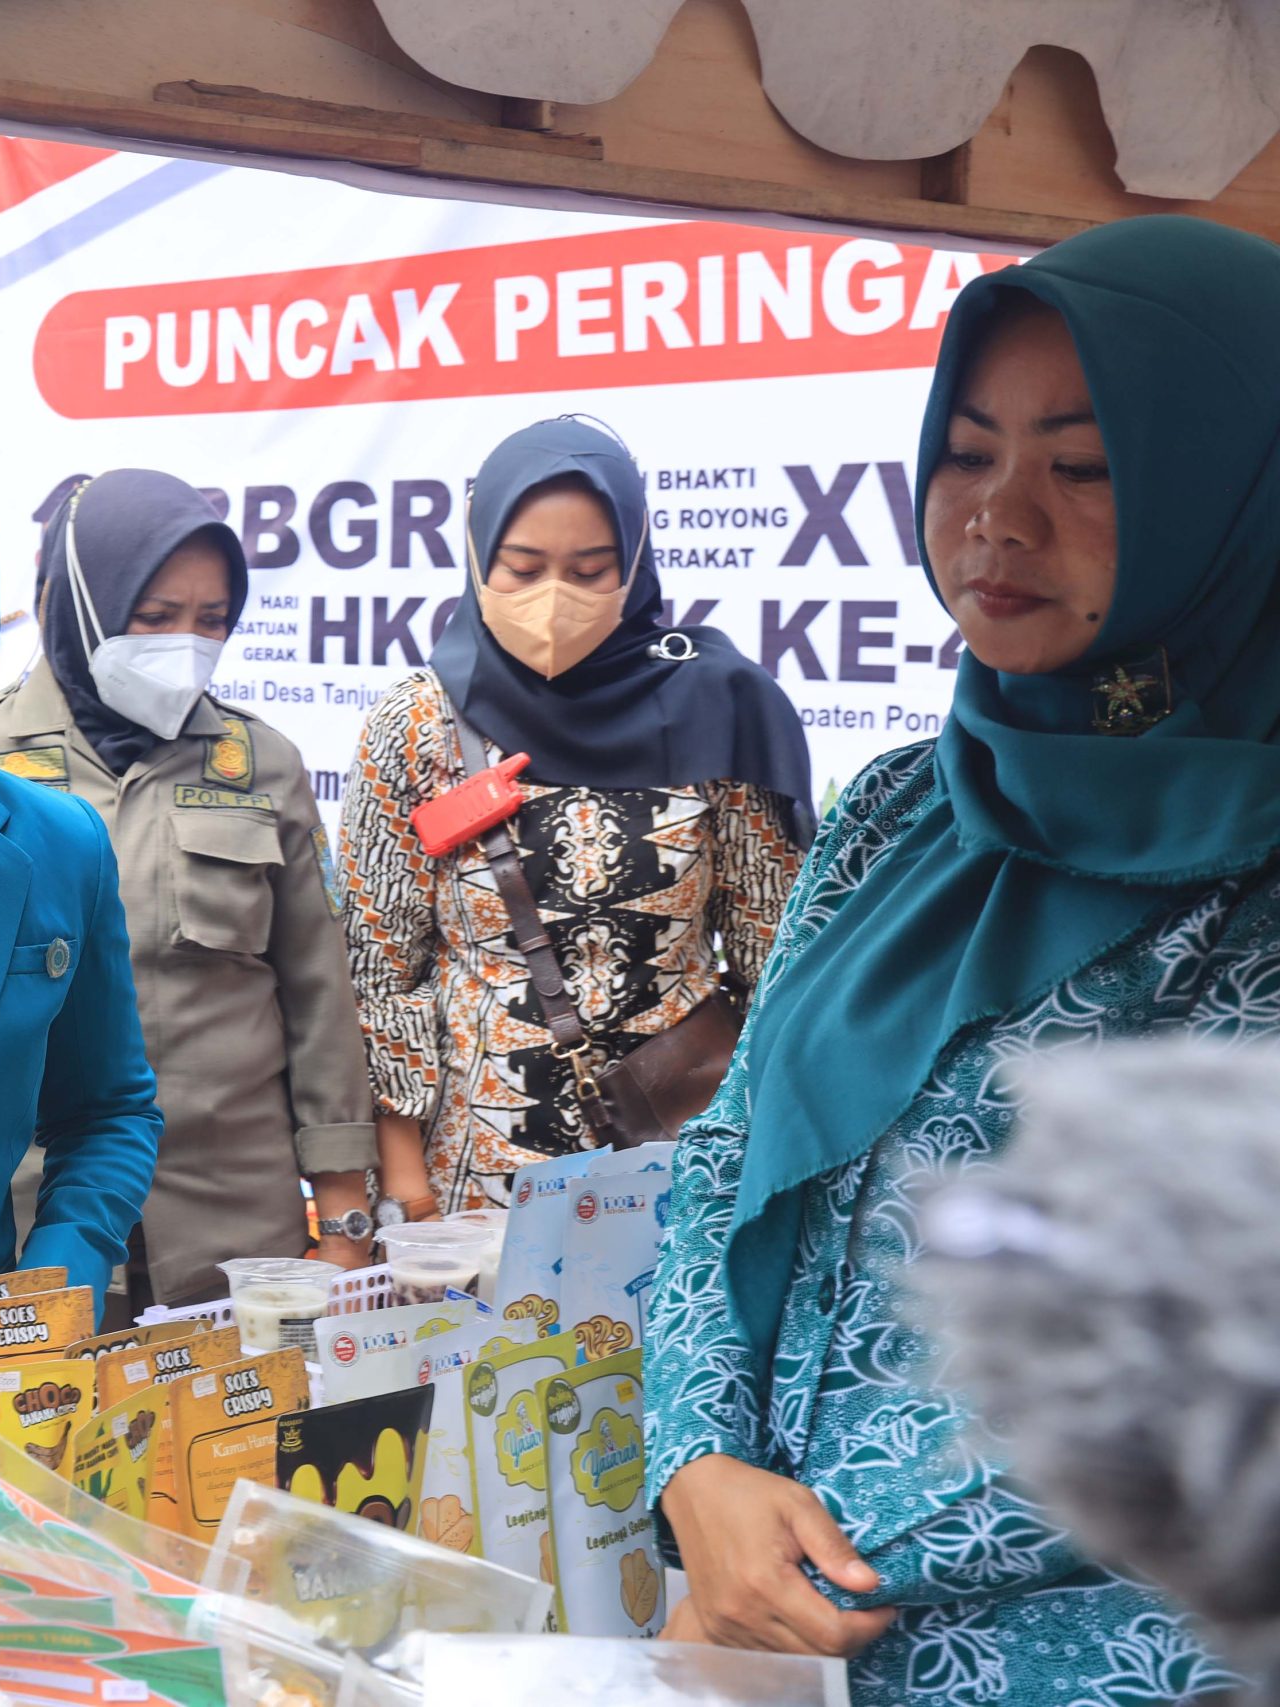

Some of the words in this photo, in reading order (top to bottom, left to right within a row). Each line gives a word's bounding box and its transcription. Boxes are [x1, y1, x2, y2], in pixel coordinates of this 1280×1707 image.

[104, 282, 464, 390] PUNCAK
[494, 238, 988, 362] PERINGA
[657, 467, 756, 490] BHAKTI
[679, 507, 789, 529] ROYONG
[653, 547, 754, 568] RRAKAT
[260, 596, 299, 609] HARI
[232, 621, 298, 636] SATUAN
[242, 647, 297, 662] GERAK
[263, 680, 315, 703] Desa
[321, 682, 384, 711] Tanju
[800, 704, 875, 730] paten
[182, 788, 228, 805] POL
[235, 794, 264, 807] PP
[0, 1303, 37, 1326] SOES
[154, 1345, 193, 1372] SOES
[223, 1366, 260, 1395] SOES
[12, 1381, 82, 1415] CHOCO
[222, 1386, 274, 1418] CRISPY
